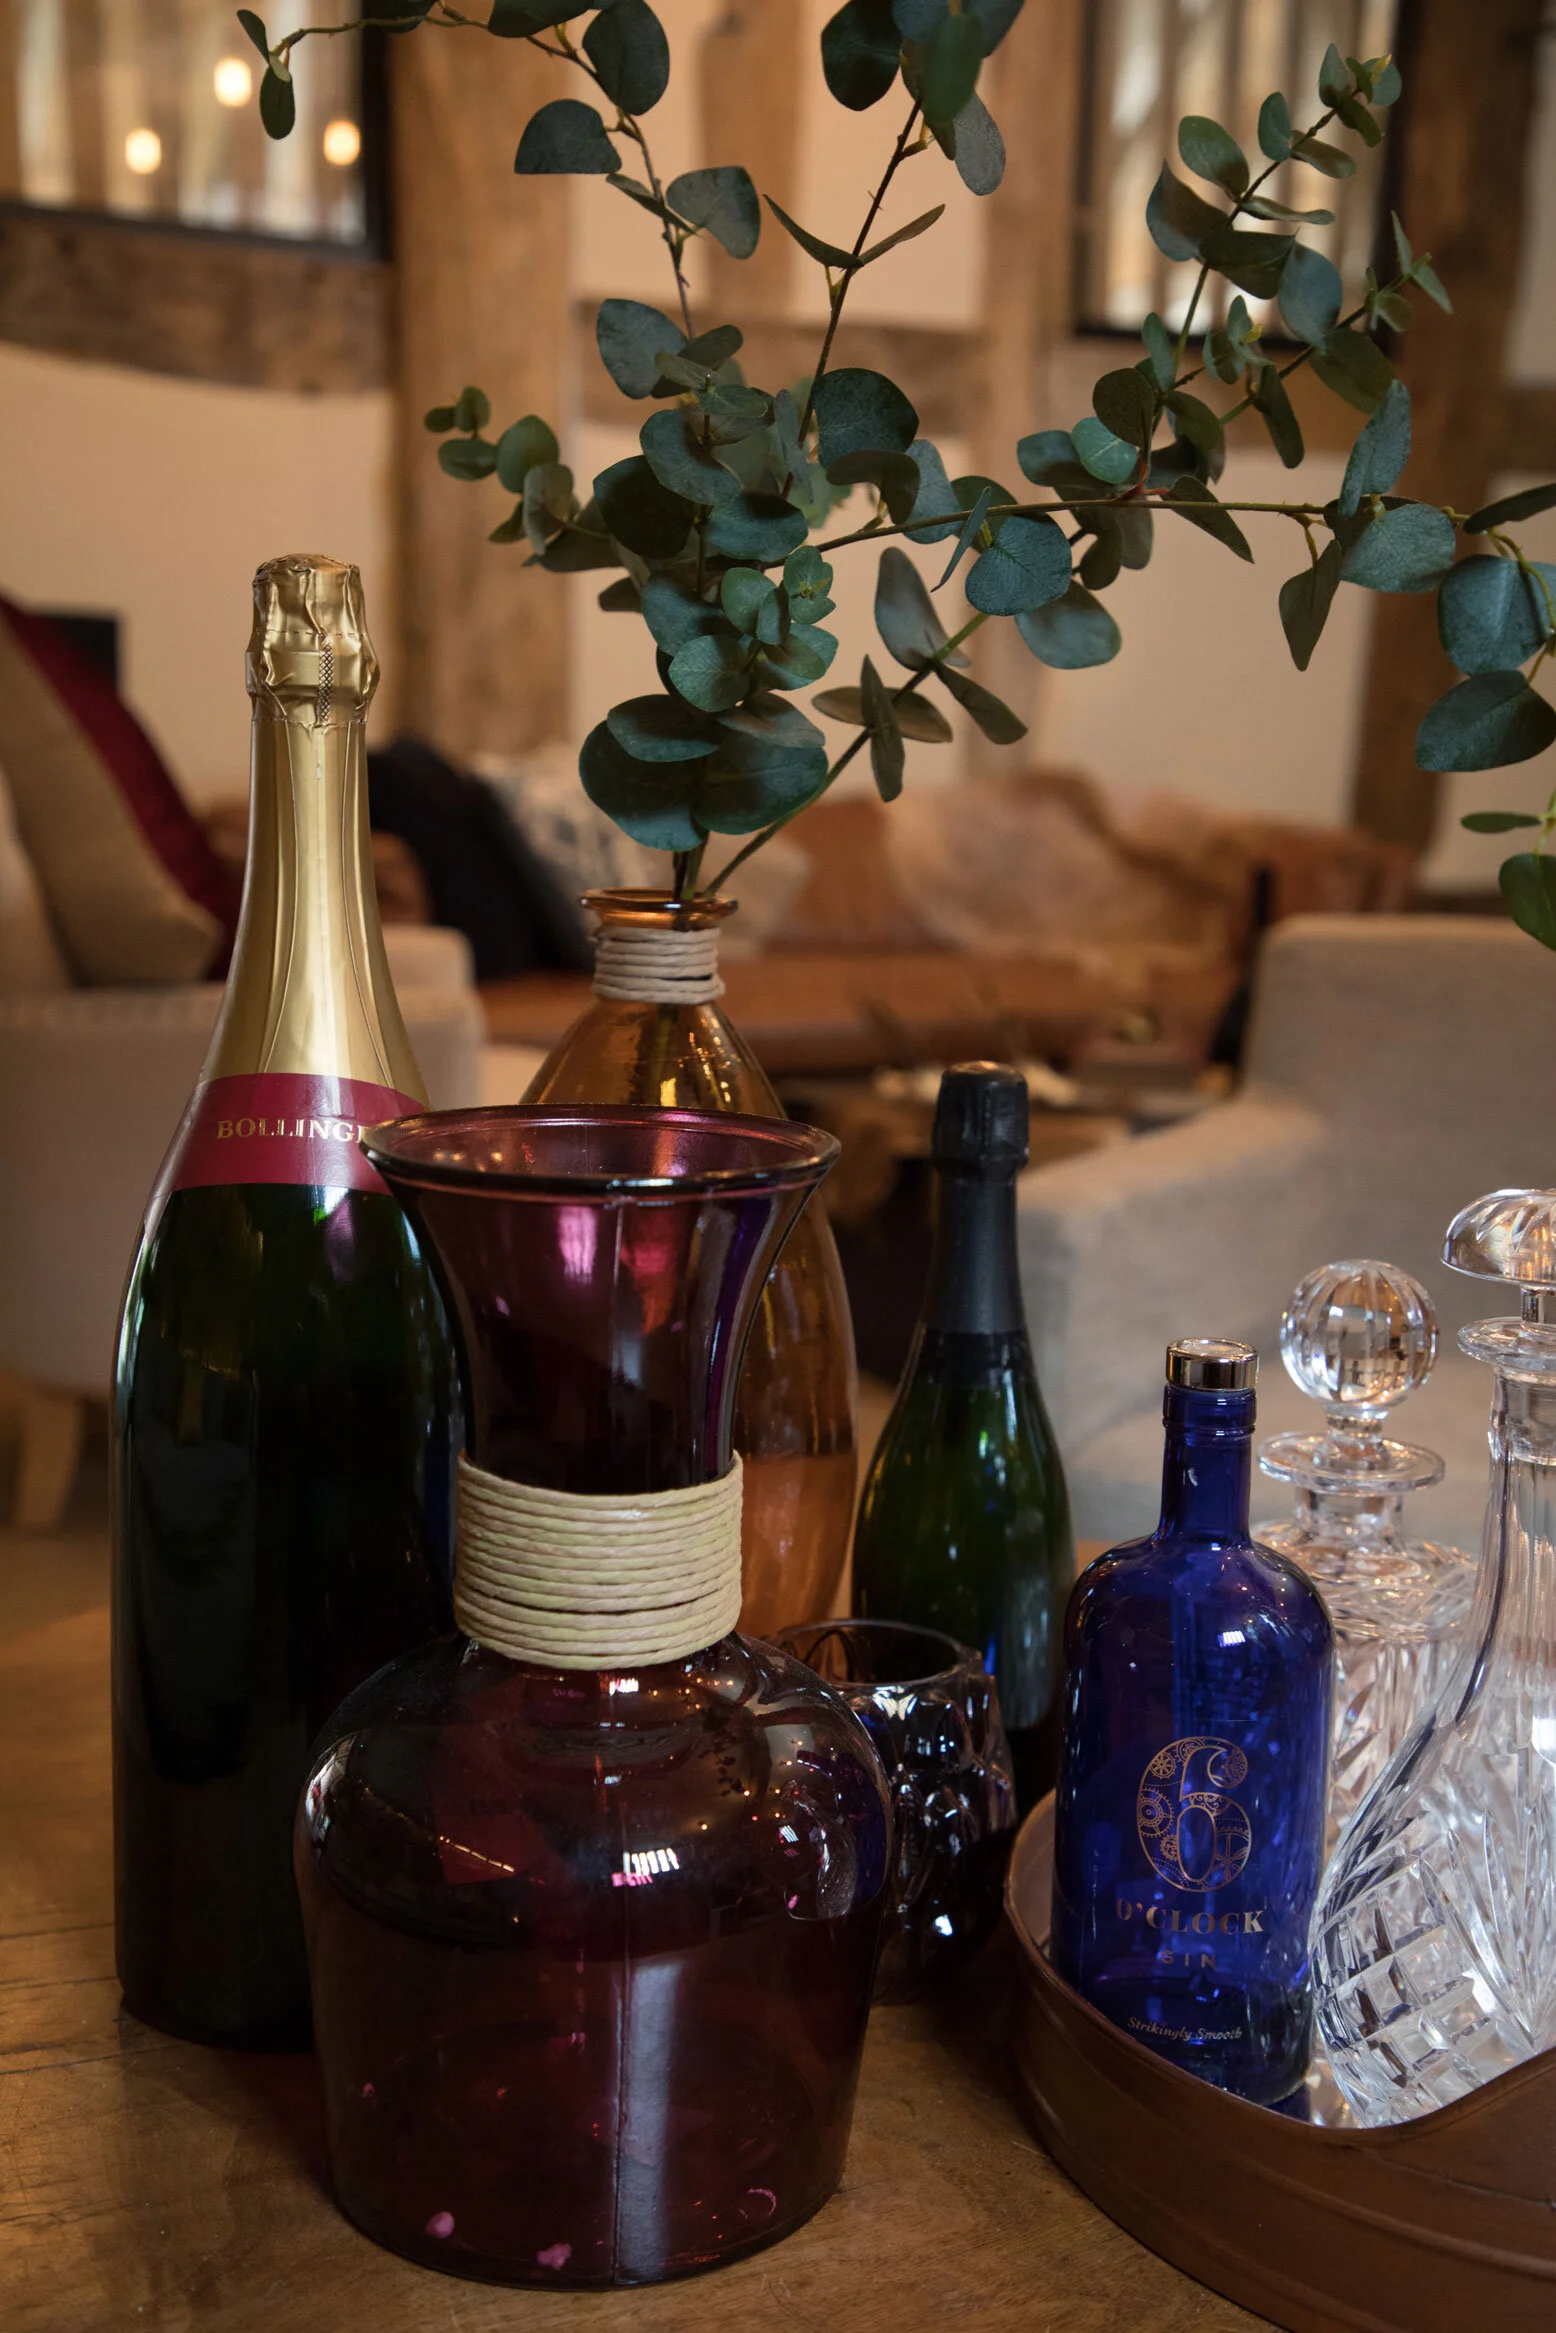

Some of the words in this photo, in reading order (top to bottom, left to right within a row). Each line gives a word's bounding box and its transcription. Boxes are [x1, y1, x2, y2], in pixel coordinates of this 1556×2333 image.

[1136, 1736, 1252, 1893] 6
[1116, 1899, 1264, 1935] O'CLOCK
[1161, 1951, 1217, 1969] GIN
[1128, 2017, 1192, 2041] Strikingly
[1196, 2027, 1243, 2040] Smooth
